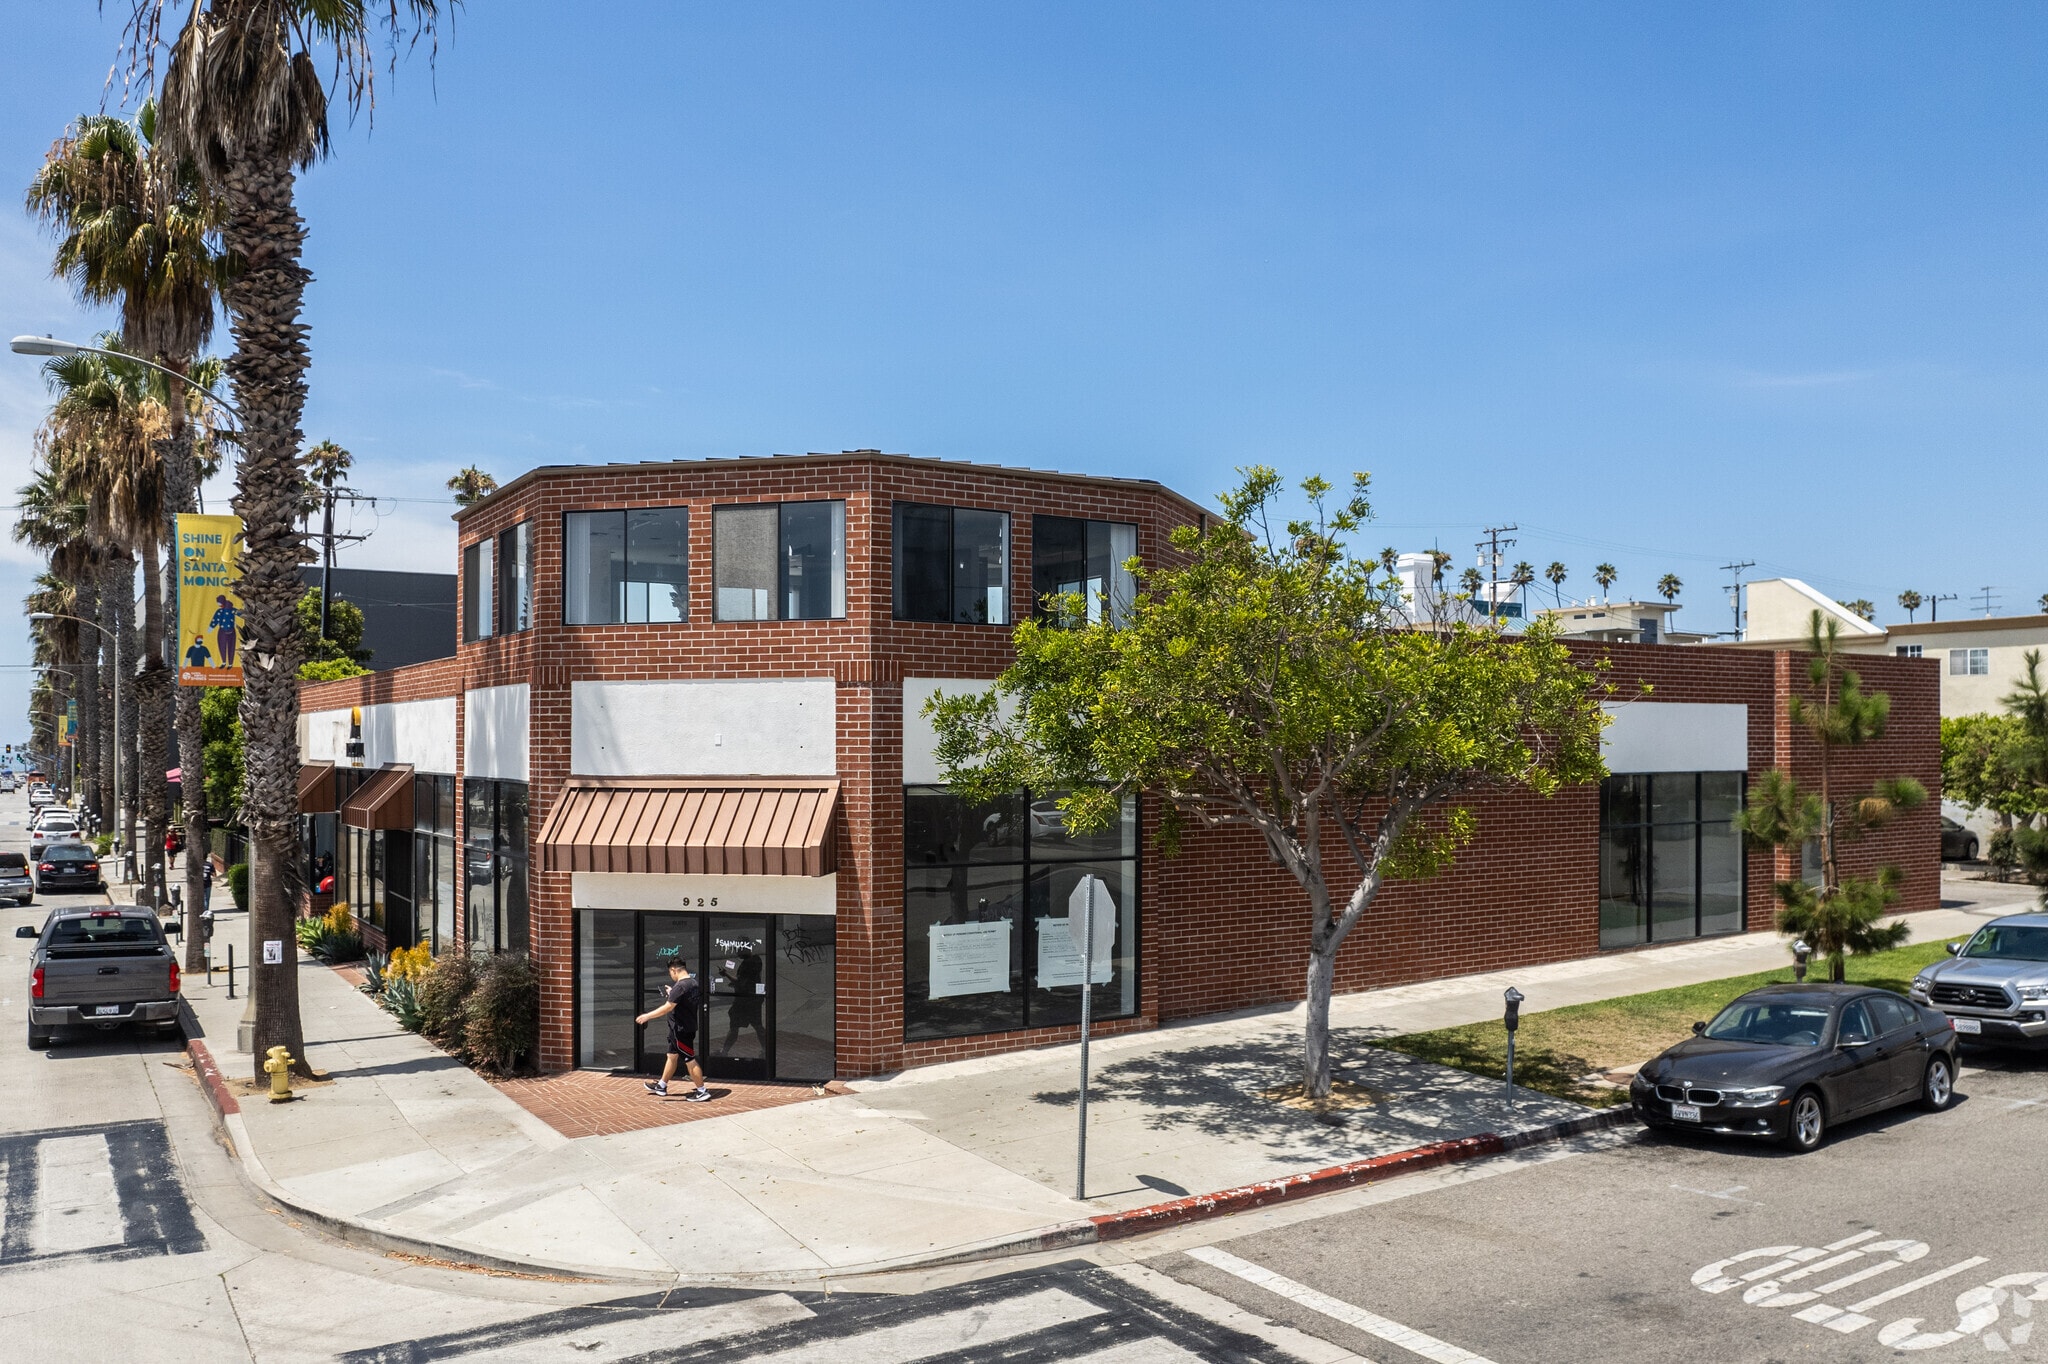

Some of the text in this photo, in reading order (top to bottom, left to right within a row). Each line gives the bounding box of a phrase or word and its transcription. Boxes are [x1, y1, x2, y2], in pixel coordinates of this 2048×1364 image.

[183, 533, 222, 544] SHINE
[184, 547, 205, 557] ON
[184, 562, 227, 573] SANTA
[184, 576, 232, 587] MONIC
